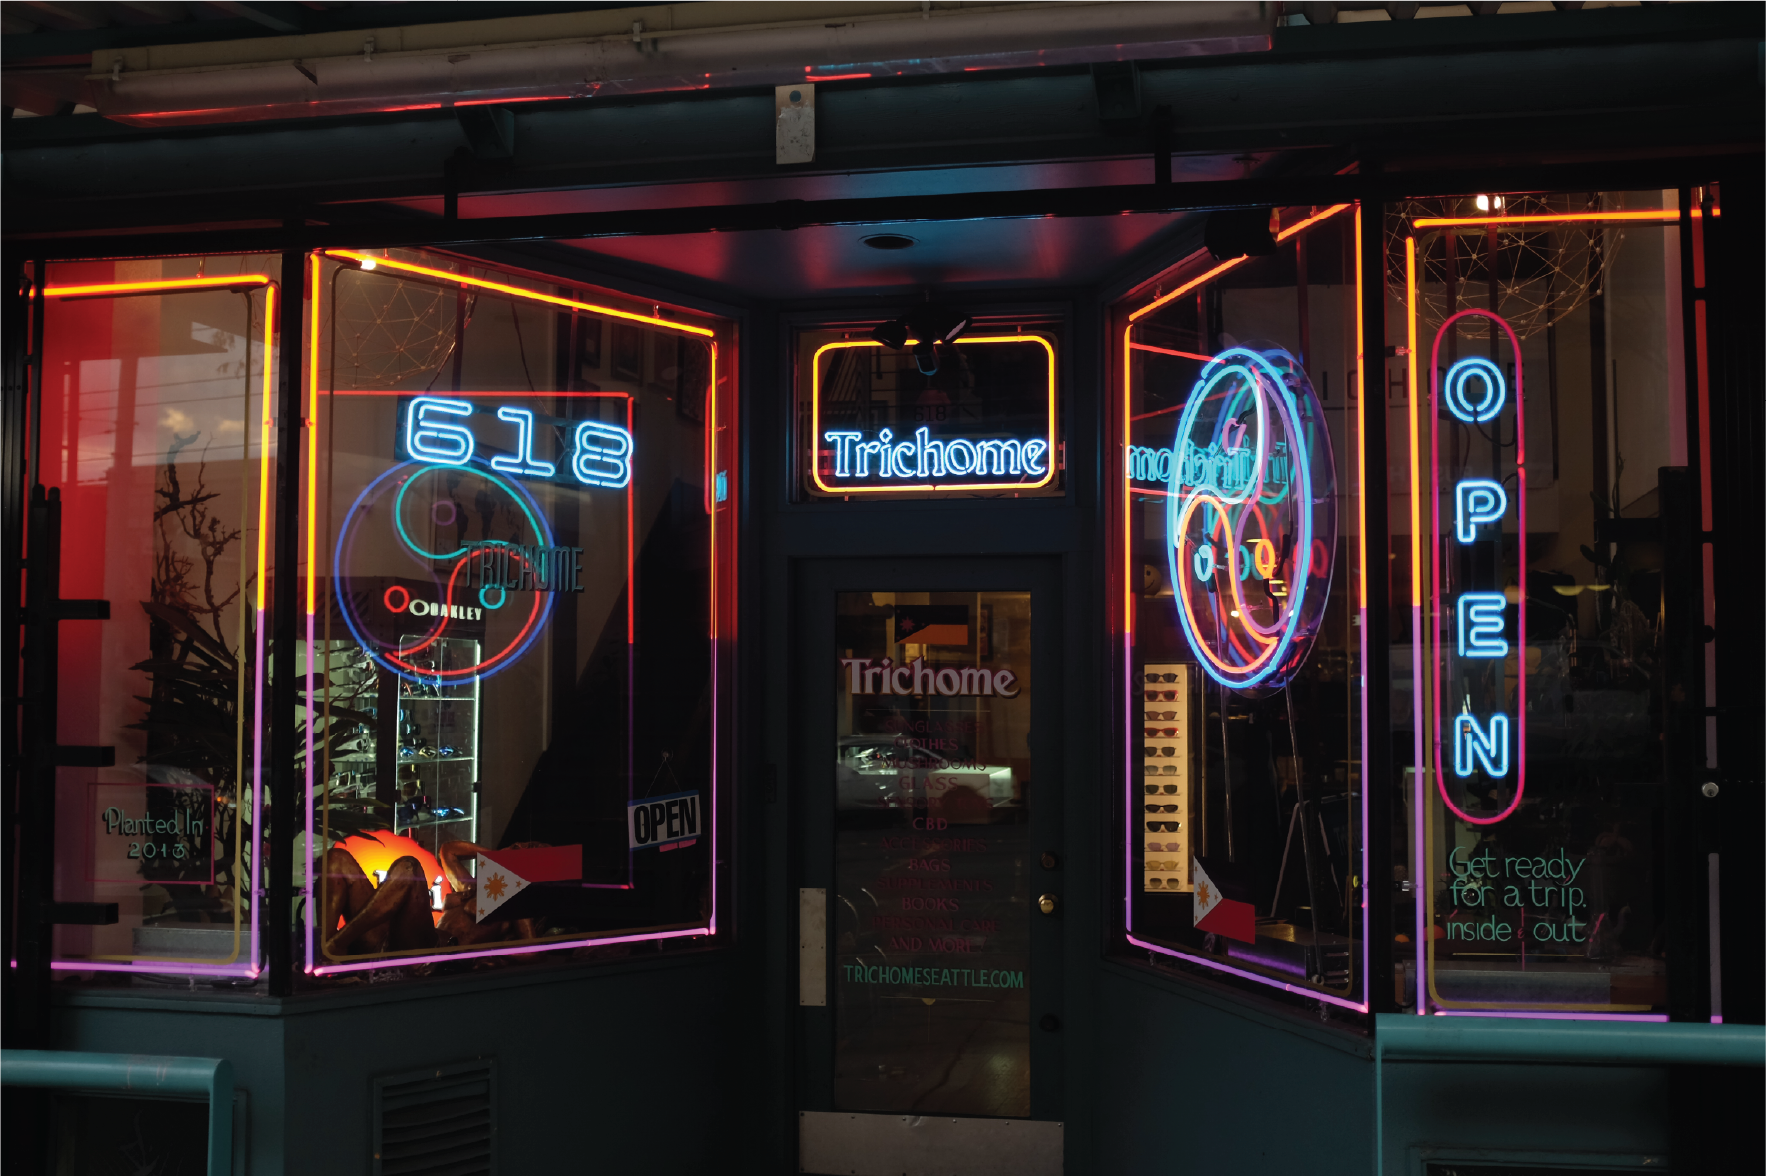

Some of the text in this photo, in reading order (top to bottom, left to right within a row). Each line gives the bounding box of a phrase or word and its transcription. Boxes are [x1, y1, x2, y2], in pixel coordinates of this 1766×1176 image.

[914, 406, 947, 421] 618
[407, 396, 633, 489] 618
[824, 426, 1047, 477] Trichome
[460, 540, 585, 592] TRICHOME
[1445, 358, 1509, 777] OPEN
[839, 655, 1021, 699] Trichome
[885, 720, 985, 733] SUNGLASSES
[894, 737, 958, 750] CLOTHES
[883, 757, 986, 770] MUSHROOMS
[899, 777, 958, 790] GLASS
[103, 807, 203, 835] Planted In
[634, 797, 696, 844] OPEN
[912, 817, 948, 830] CBD
[129, 842, 185, 859] 2013
[880, 837, 987, 852] ACCESSORIES
[909, 858, 951, 872] BAGS
[1449, 846, 1586, 886] Get ready
[877, 877, 994, 892] SUPPLEMENTS
[902, 898, 959, 911] BOOKS
[1449, 879, 1587, 915] for a trip.
[872, 916, 1000, 932] PERSONAL CARE
[1447, 914, 1512, 941] inside
[889, 936, 922, 951] AND
[844, 965, 1024, 988] TRICHOMESEATTLE.COM
